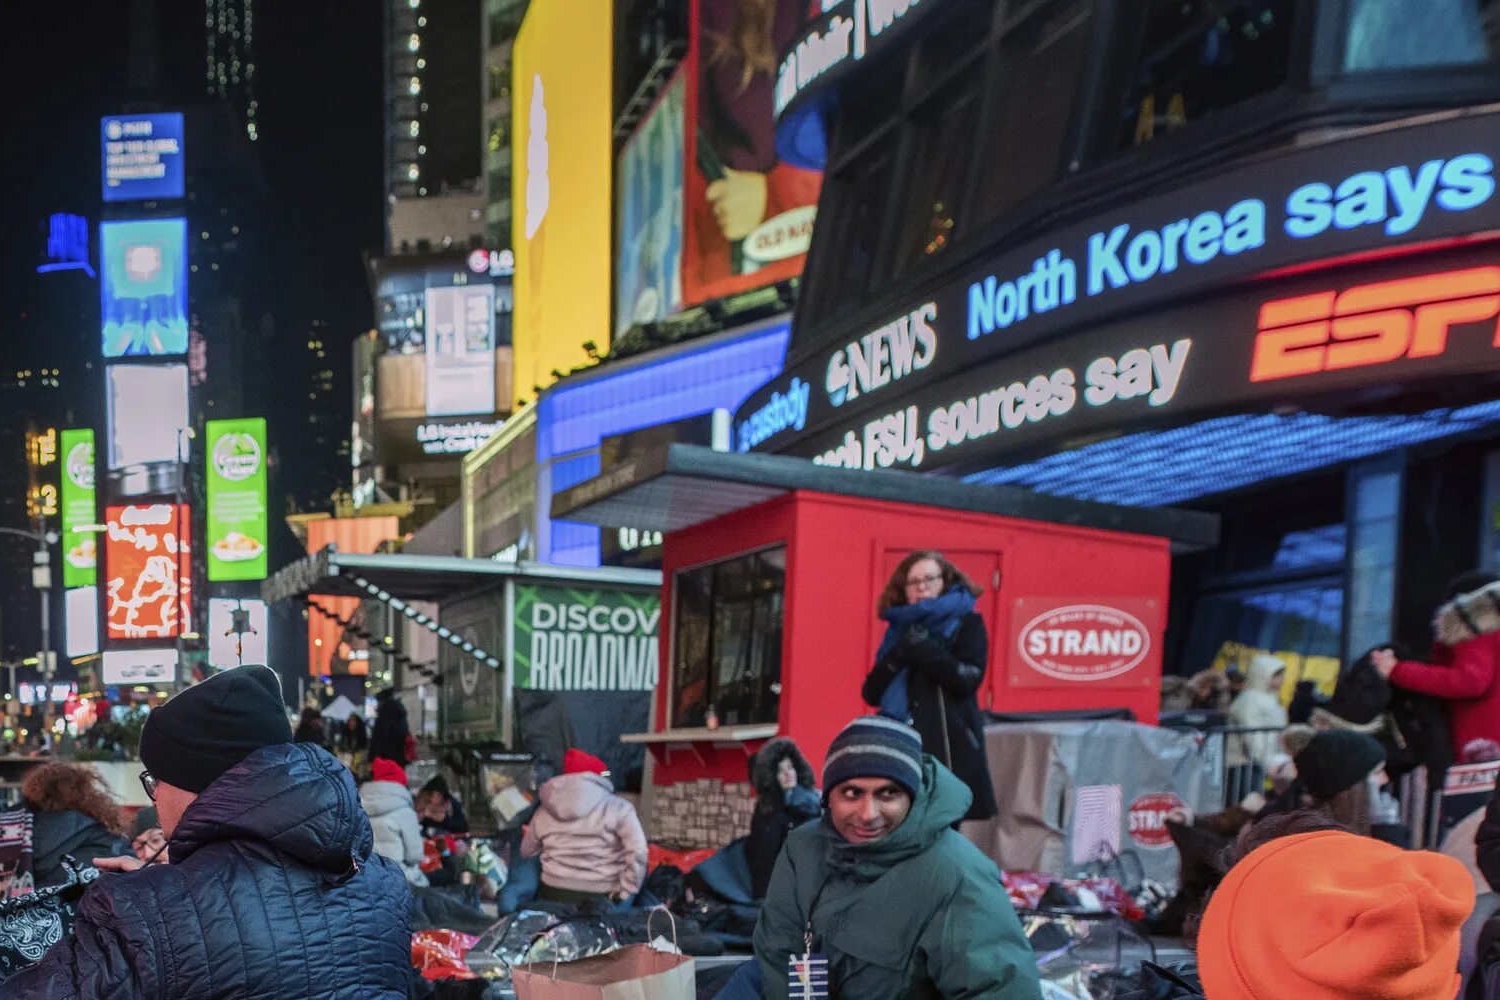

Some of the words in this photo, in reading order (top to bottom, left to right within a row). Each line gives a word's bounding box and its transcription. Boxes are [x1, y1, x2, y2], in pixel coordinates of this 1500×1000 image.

[489, 249, 515, 275] LG
[967, 248, 1077, 341] North
[1086, 198, 1267, 297] Korea
[1283, 153, 1498, 237] says
[845, 302, 938, 400] NEWS
[1249, 265, 1500, 383] ESP
[863, 405, 925, 472] FSU,
[926, 367, 1077, 452] sources
[1084, 338, 1192, 407] say
[532, 602, 661, 635] DISCOV
[1028, 629, 1142, 657] STRAND
[530, 630, 660, 692] BROADWA
[1128, 809, 1169, 832] STRA
